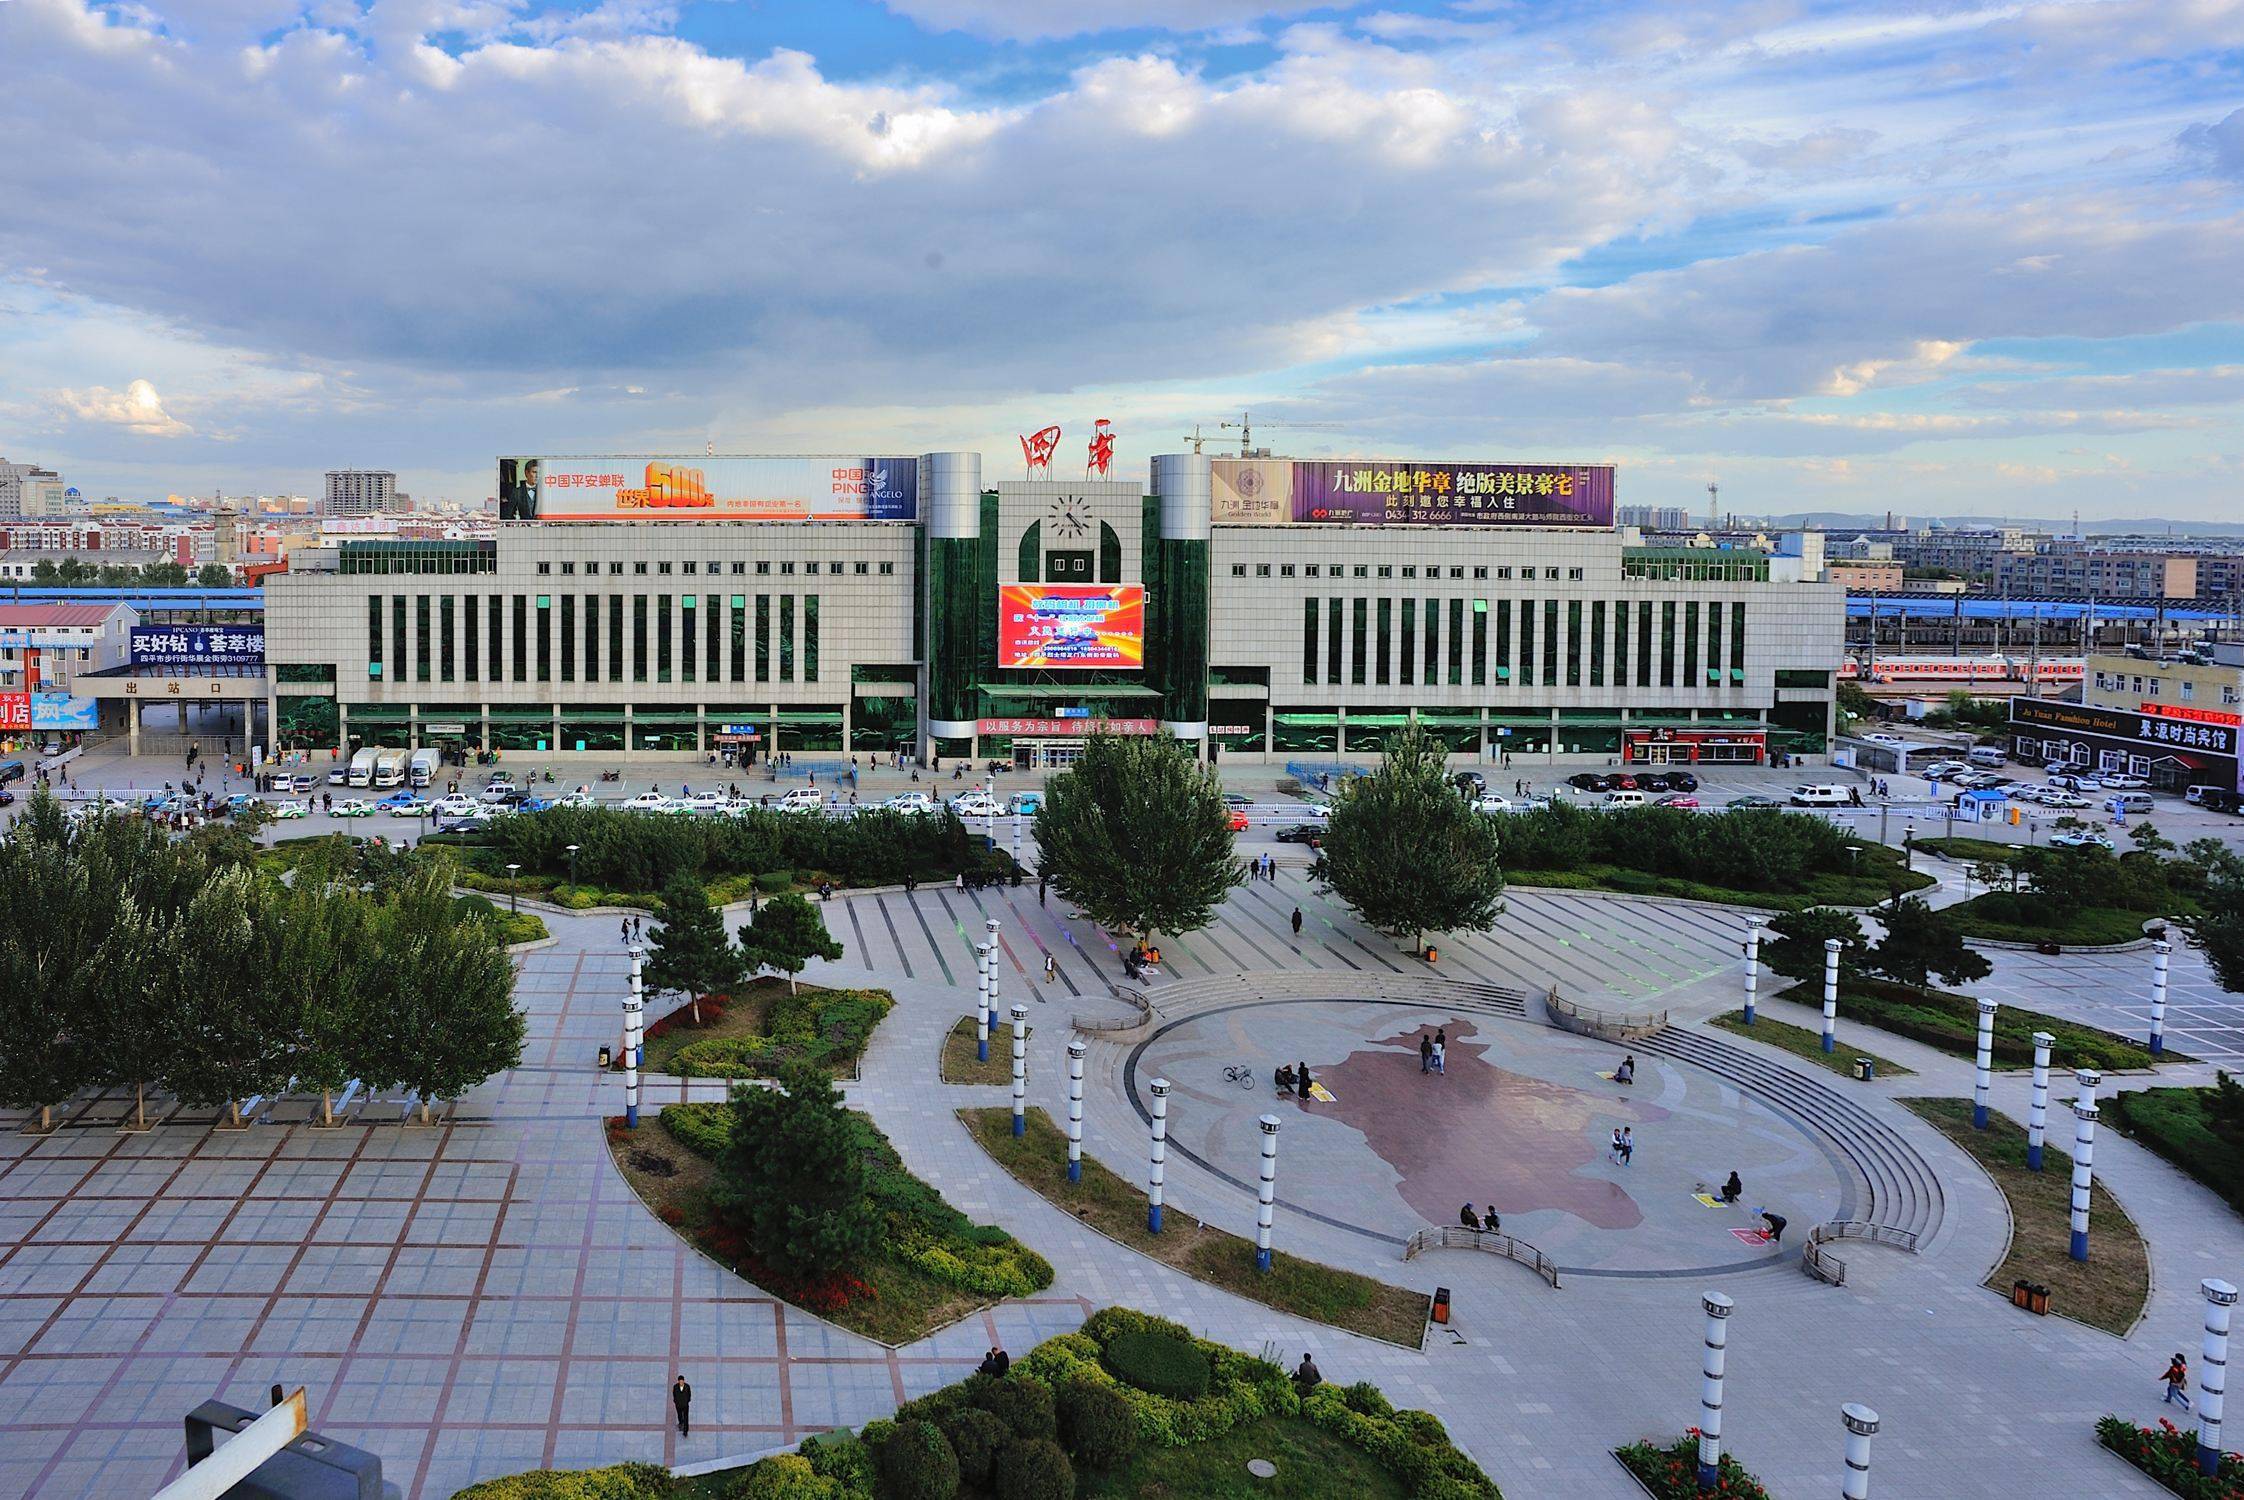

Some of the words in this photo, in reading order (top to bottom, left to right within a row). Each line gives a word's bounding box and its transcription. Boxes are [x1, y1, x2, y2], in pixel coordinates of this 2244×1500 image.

[544, 474, 625, 488] 中国平安蝉联
[1333, 470, 1451, 493] 九洲金地华章
[1455, 471, 1573, 496] 绝版美景豪宅
[1385, 495, 1516, 508] 此刻邀您幸福入住
[1385, 510, 1407, 520] 0434
[1412, 511, 1427, 520] 312
[1429, 511, 1452, 520] 6666
[132, 634, 188, 652] 买好钻
[209, 634, 265, 652] 荟萃楼
[126, 682, 221, 694] 出站口
[986, 721, 1061, 732] 以服务为宗旨
[2092, 717, 2117, 729] Hotel
